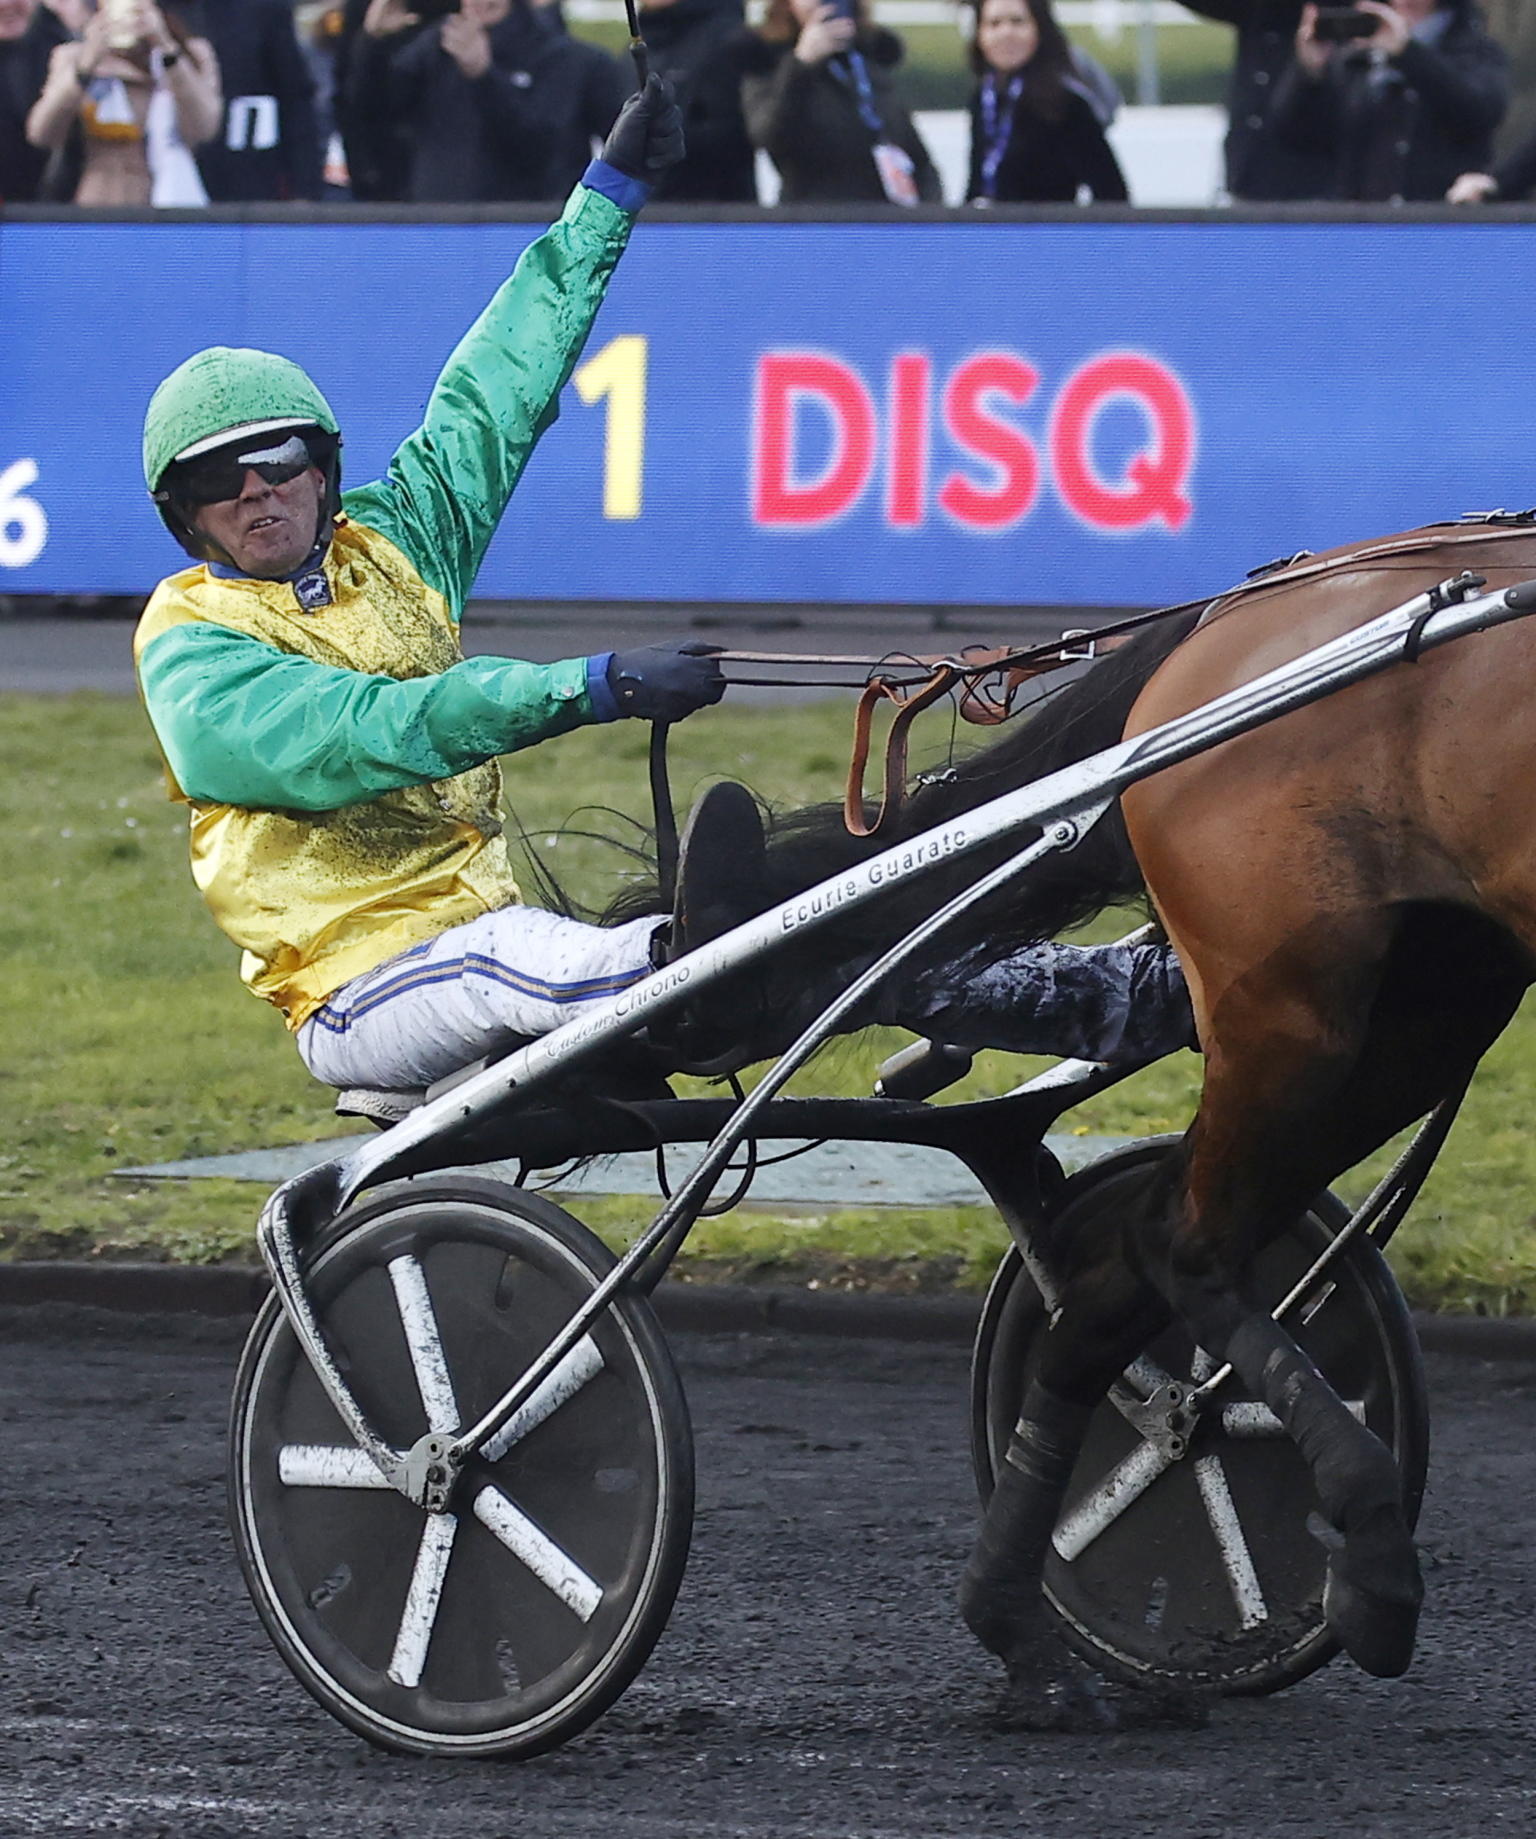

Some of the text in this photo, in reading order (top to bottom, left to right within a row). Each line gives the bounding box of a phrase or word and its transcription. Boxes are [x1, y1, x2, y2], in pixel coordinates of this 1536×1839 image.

[574, 334, 1195, 535] 1 DISQ
[0, 457, 49, 569] 6
[781, 879, 857, 931] Ecurie
[615, 967, 690, 1016] Chrono
